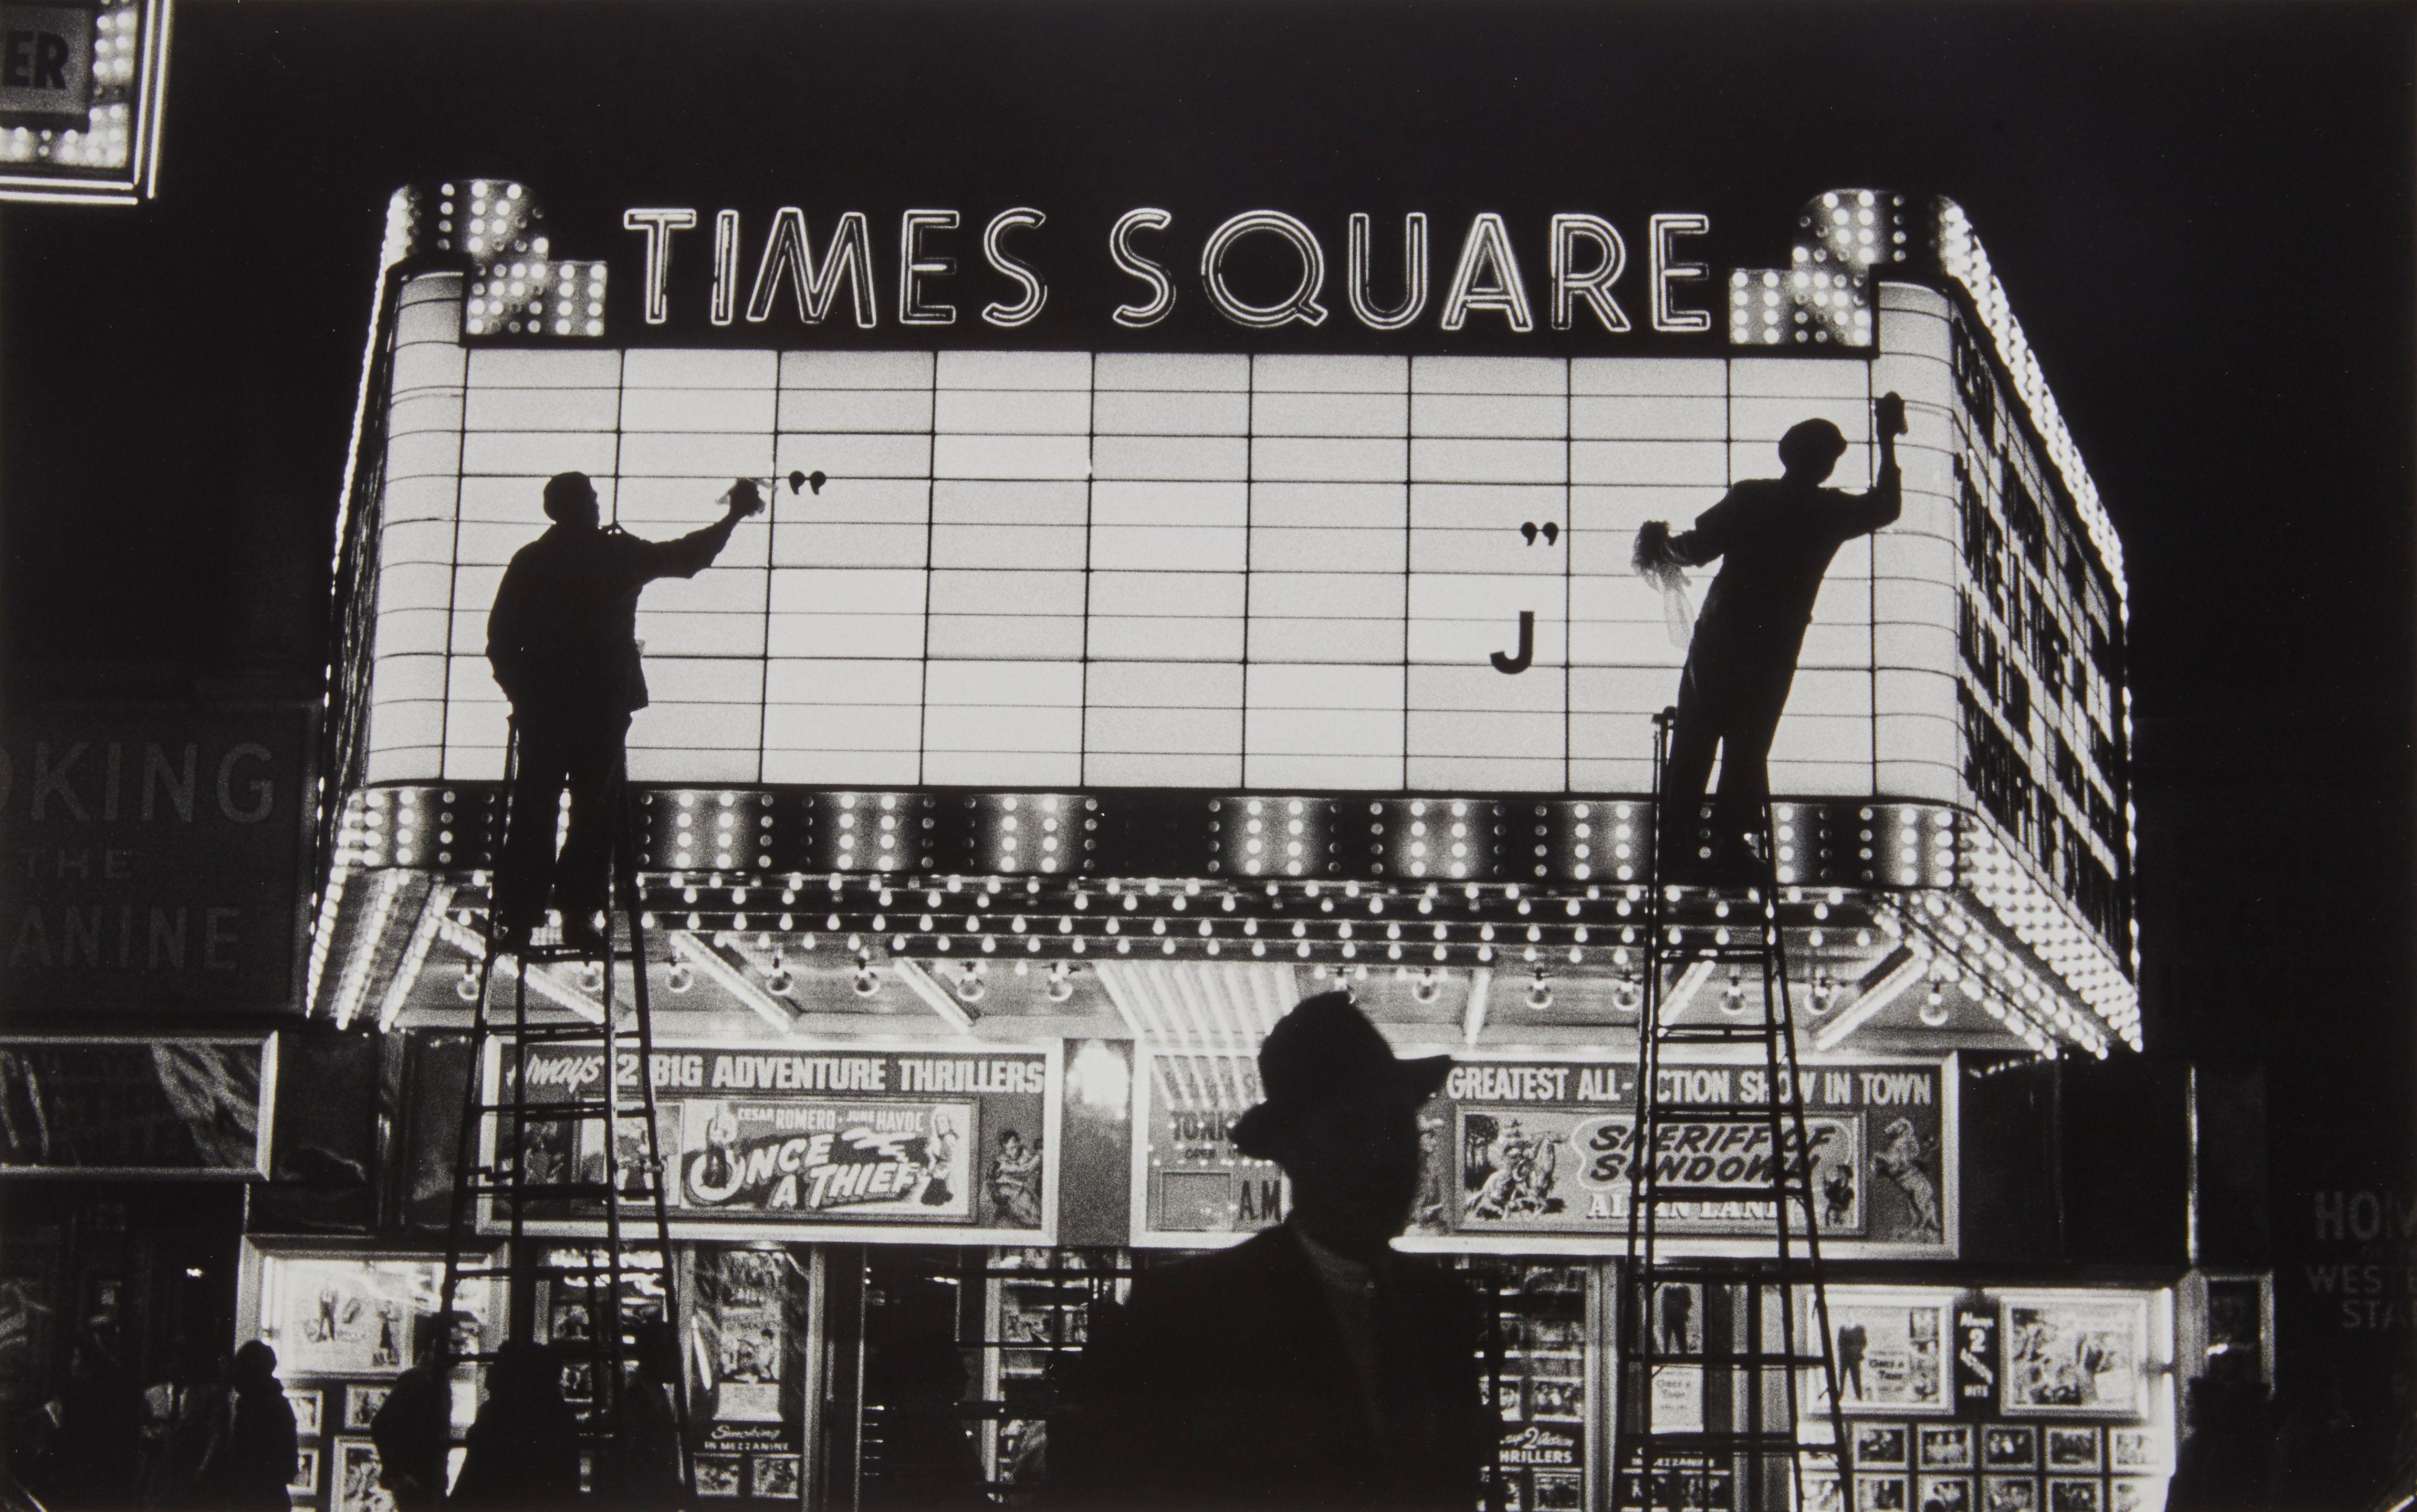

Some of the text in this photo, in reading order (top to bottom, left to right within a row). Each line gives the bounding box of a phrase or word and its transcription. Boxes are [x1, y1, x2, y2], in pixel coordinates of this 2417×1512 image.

[624, 206, 1710, 332] TIMES SQUARE
[1490, 611, 1534, 675] J
[618, 1054, 639, 1087] 2
[649, 1055, 703, 1087] BIG
[712, 1056, 886, 1090] ADVENTURE
[897, 1059, 1045, 1094] THRILLERS
[1446, 1067, 1570, 1101] GREATEST
[1824, 1072, 1852, 1105] IN
[1858, 1073, 1932, 1106] TOWN
[776, 1108, 836, 1131] ROMERO
[876, 1110, 924, 1132] HAVOC
[690, 1133, 835, 1202] ONCE
[772, 1161, 921, 1209] A THIEF
